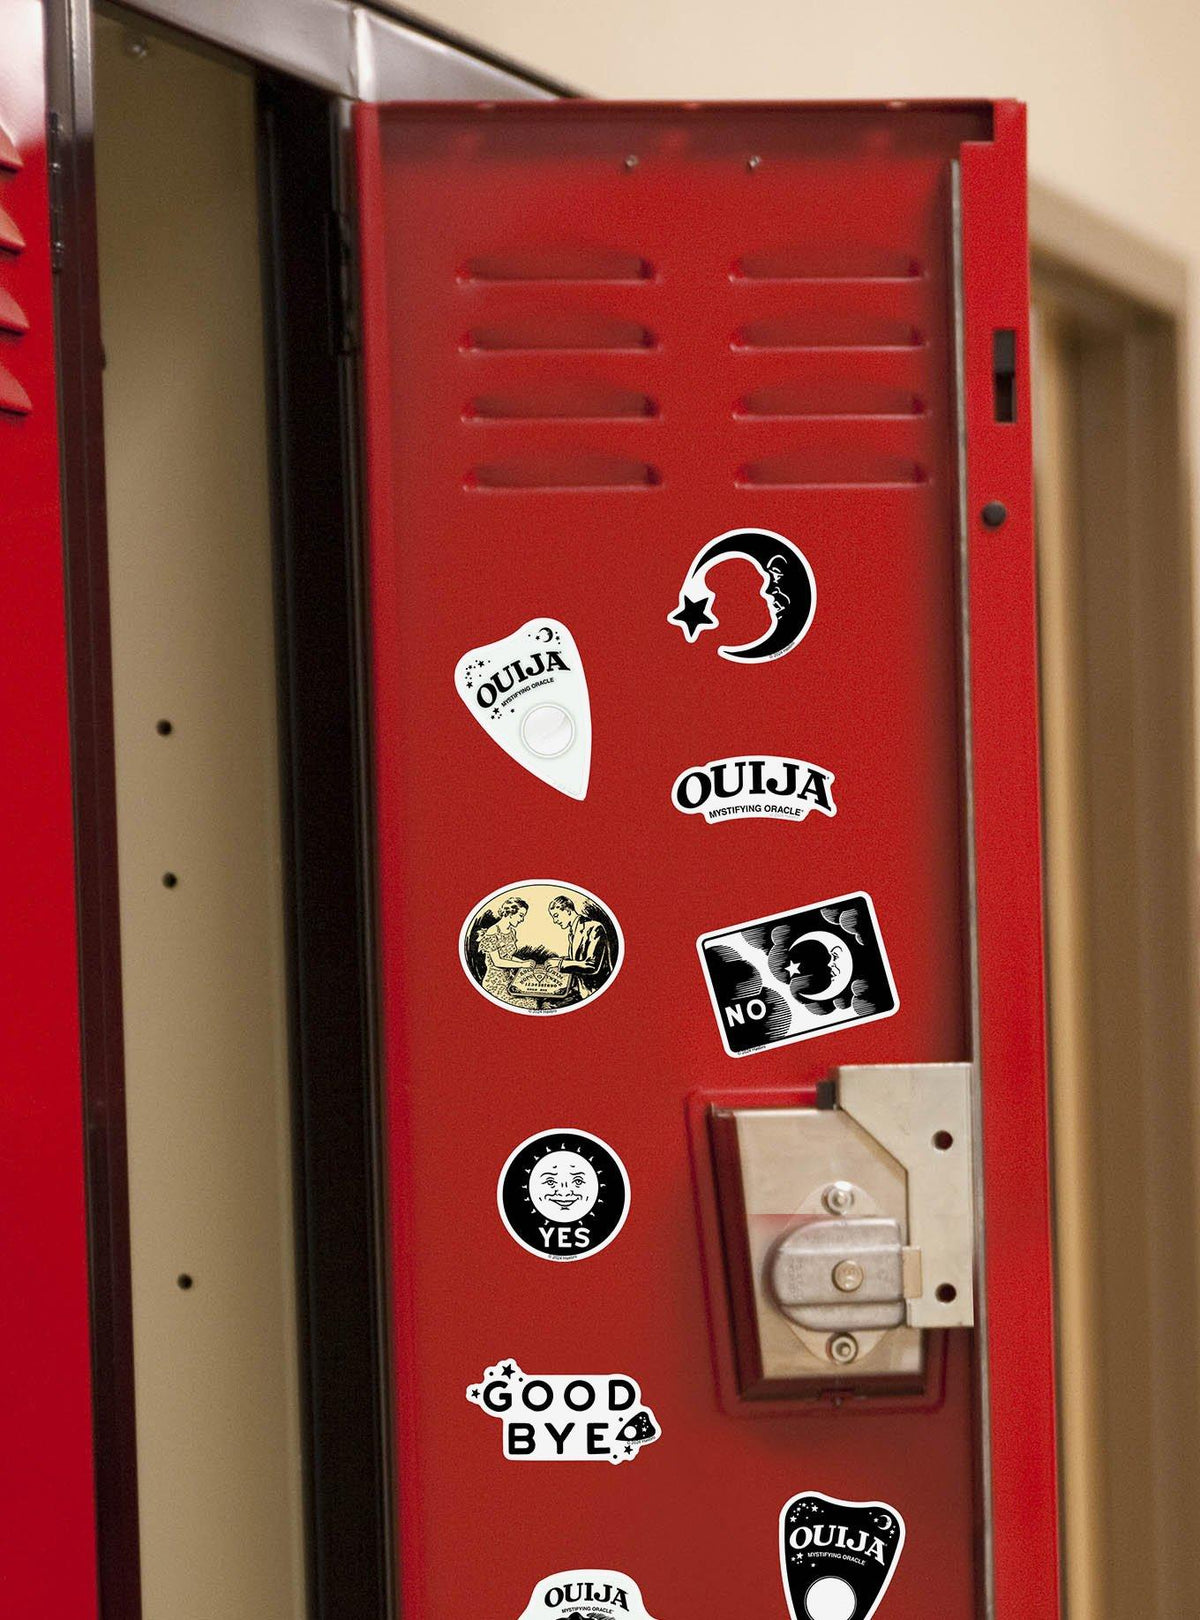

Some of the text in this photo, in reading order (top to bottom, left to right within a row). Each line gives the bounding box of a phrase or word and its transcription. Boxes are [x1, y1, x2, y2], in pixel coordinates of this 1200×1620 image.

[476, 651, 571, 709] OUIJA
[500, 677, 555, 708] MYSTIFYING ORACLE
[677, 760, 832, 812] OUIJA
[708, 804, 762, 819] MYSTIFYING
[764, 804, 802, 818] ORACLE
[724, 997, 767, 1028] NO
[538, 1226, 591, 1248] YES
[483, 1379, 636, 1412] GOOD
[508, 1422, 611, 1455] BYE
[789, 1524, 886, 1567] OUIJA
[807, 1551, 867, 1567] MYSTIFYING ORACLE
[544, 1582, 630, 1612] OUIJA
[561, 1605, 614, 1615] MYSTIFYING ORACLE
